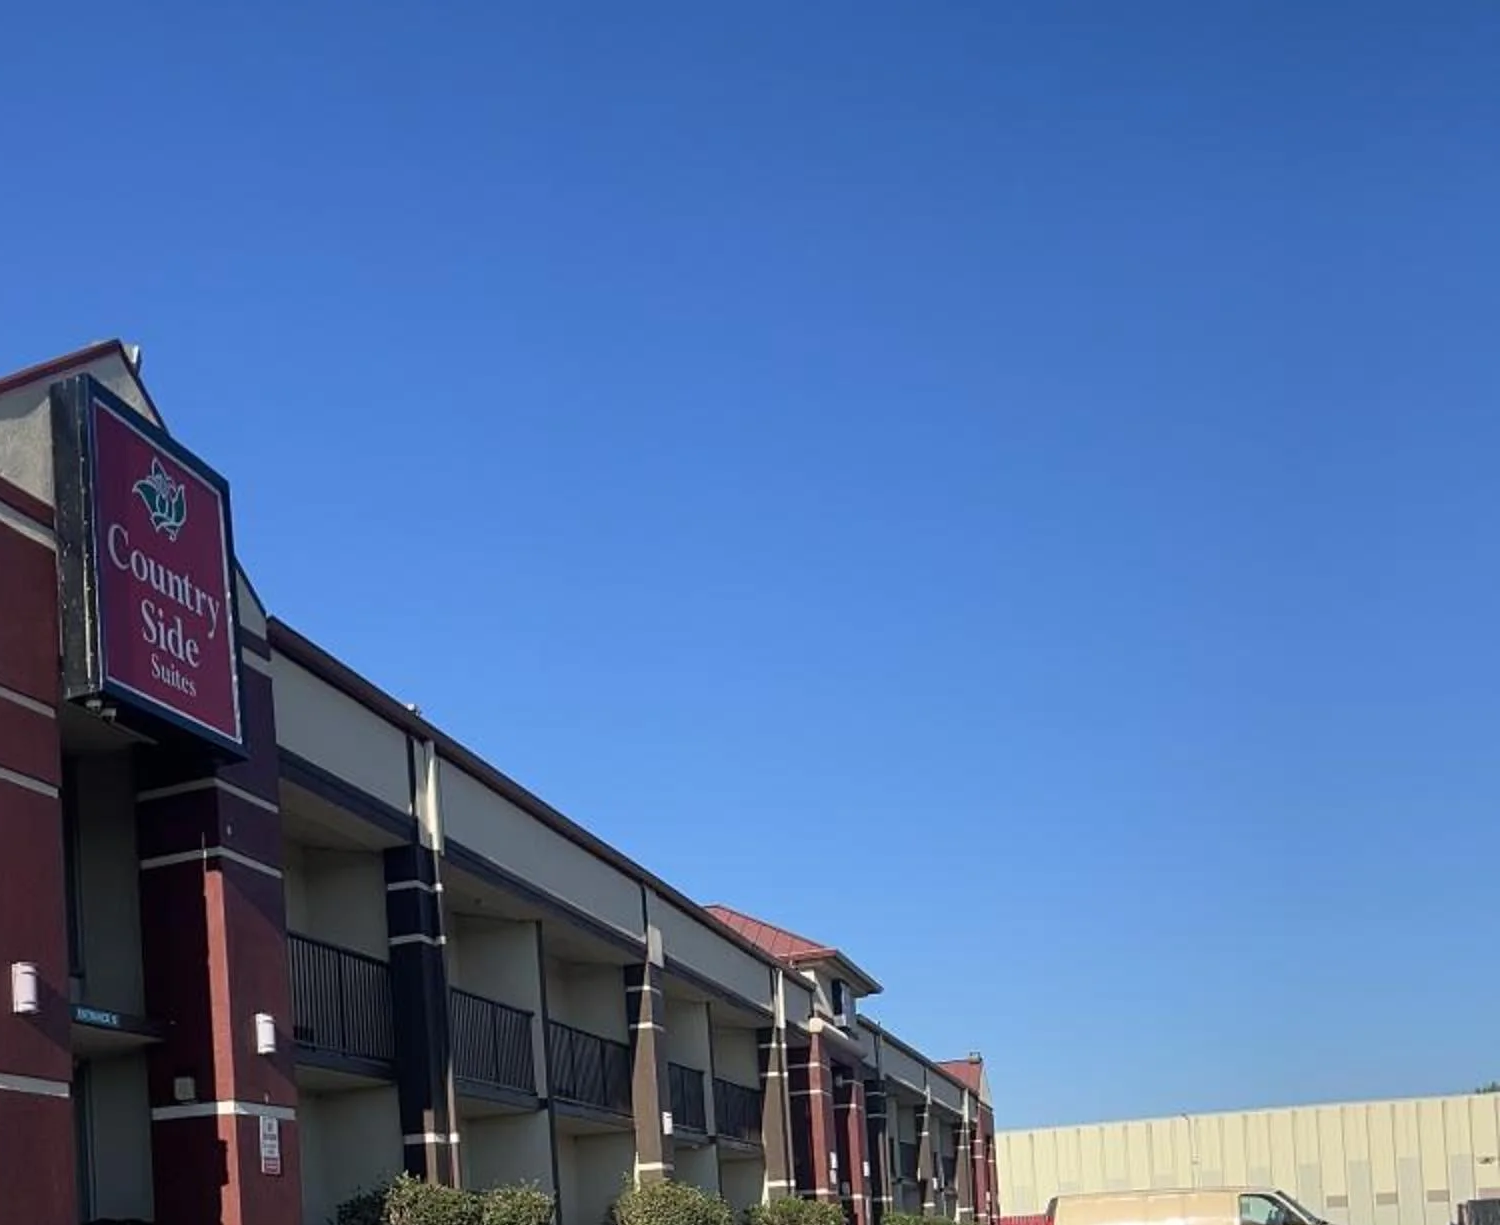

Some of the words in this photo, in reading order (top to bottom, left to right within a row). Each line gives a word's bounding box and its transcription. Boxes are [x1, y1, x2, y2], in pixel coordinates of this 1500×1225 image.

[107, 523, 220, 639] Country
[141, 599, 199, 668] Side
[150, 653, 197, 697] Suites
